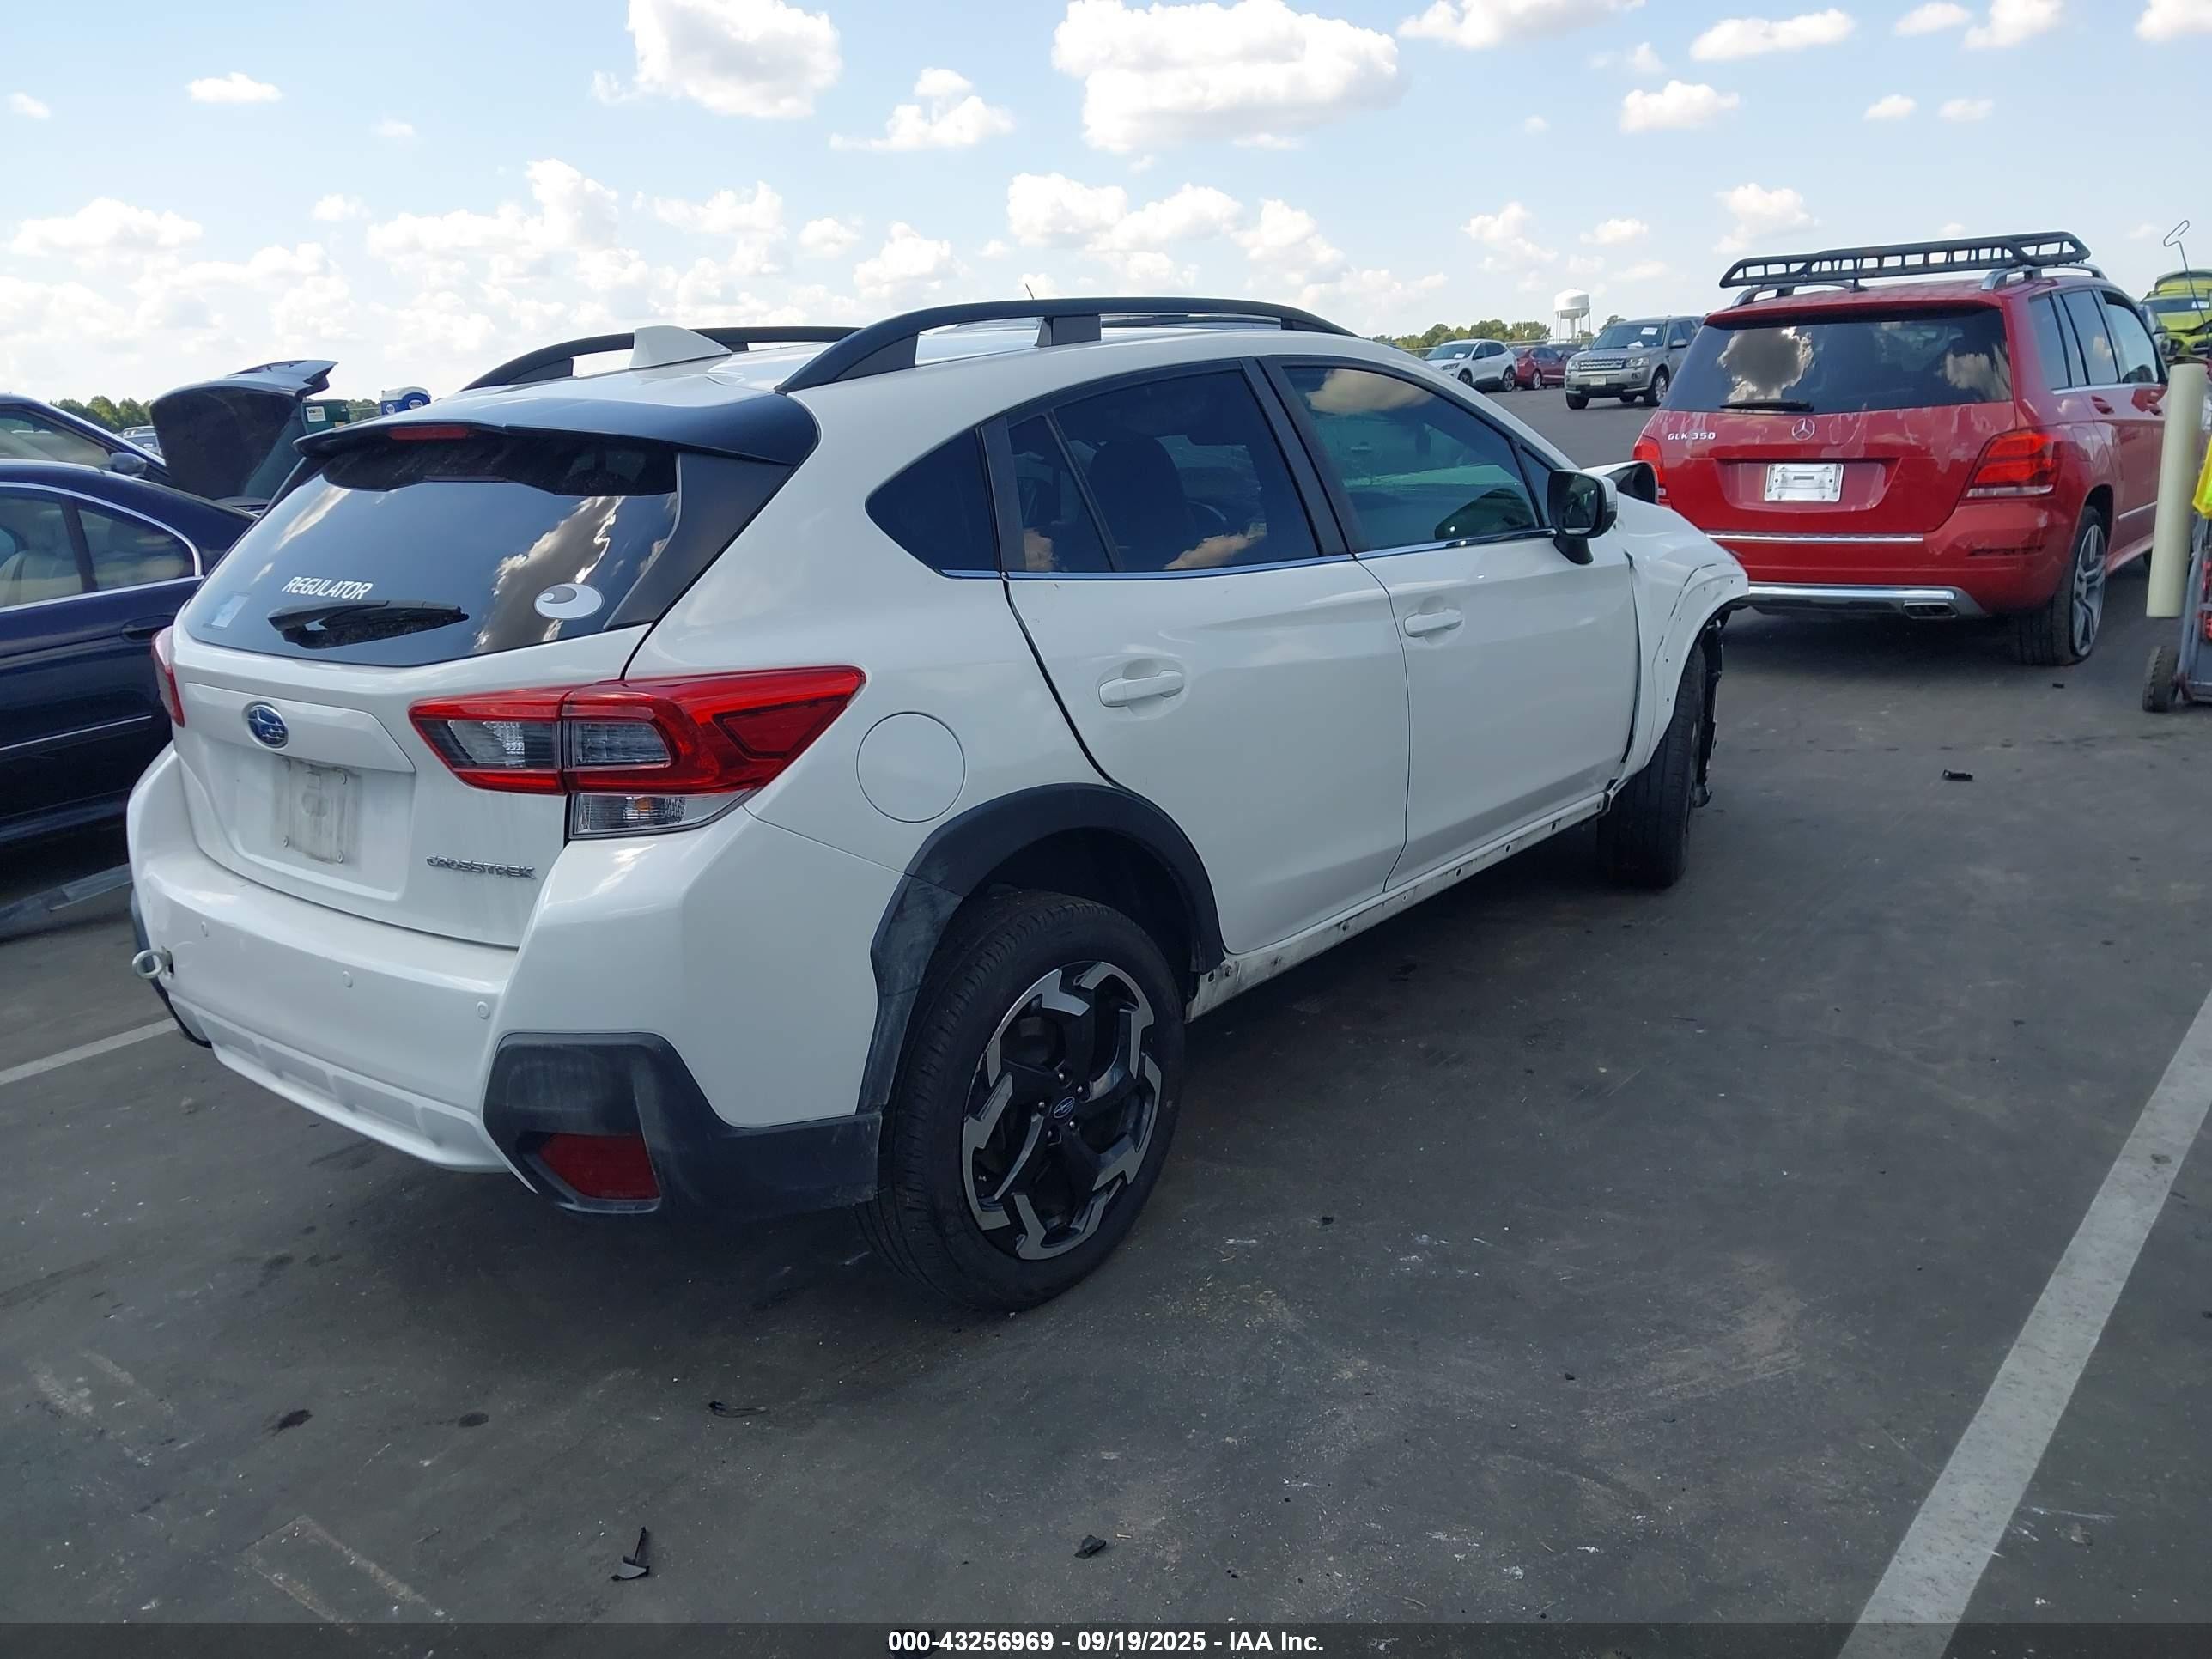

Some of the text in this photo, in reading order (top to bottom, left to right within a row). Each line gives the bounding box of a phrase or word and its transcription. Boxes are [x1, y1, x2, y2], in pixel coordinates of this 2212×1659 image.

[1668, 432, 1716, 441] GLK 350
[281, 576, 374, 600] REGULATOR
[426, 855, 537, 880] CROSSTREK
